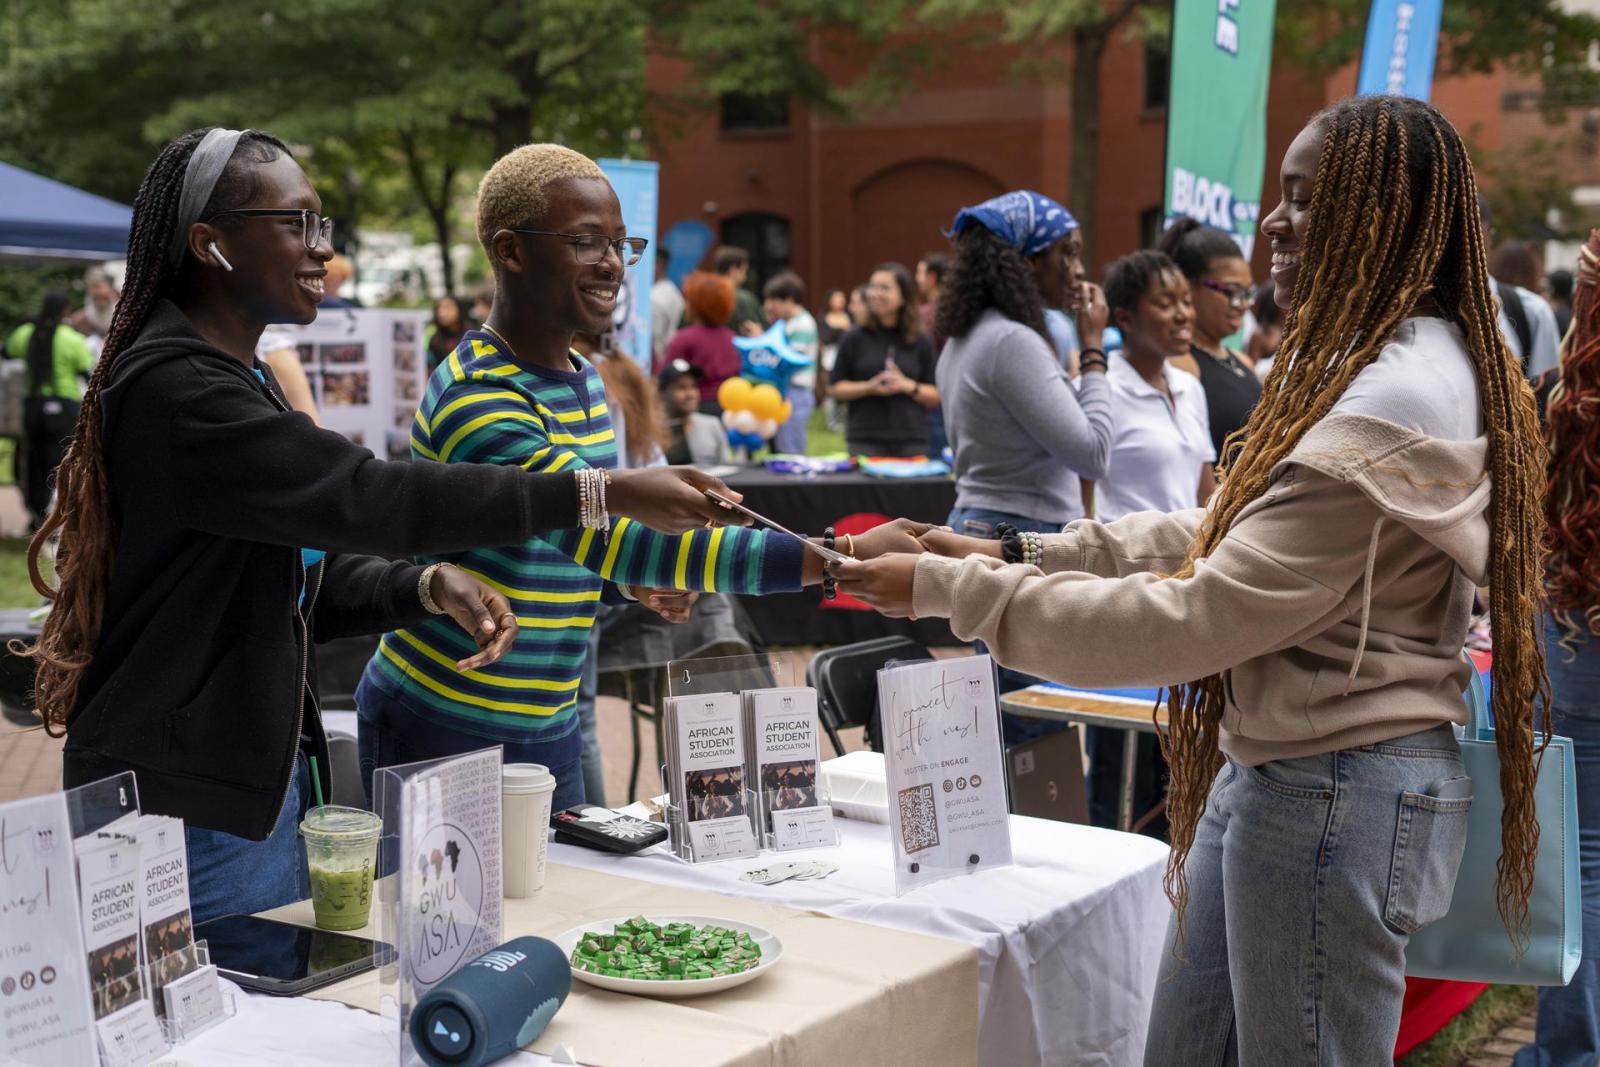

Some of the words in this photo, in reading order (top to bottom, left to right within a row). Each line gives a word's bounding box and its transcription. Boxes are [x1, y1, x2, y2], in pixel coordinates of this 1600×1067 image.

[1171, 166, 1233, 231] BLOCK
[688, 726, 733, 739] AFRICAN
[765, 720, 810, 732] AFRICAN
[689, 737, 735, 750] STUDENT
[766, 731, 811, 743] STUDENT
[766, 742, 811, 752] ASSOCIATION
[689, 749, 735, 759] ASSOCIATION
[941, 756, 969, 768] ENGAGE
[146, 857, 183, 881] AFRICAN
[91, 880, 134, 906] AFRICAN
[146, 872, 184, 896] STUDENT
[147, 887, 185, 908] ASSOCIATION
[420, 878, 456, 914] GWU
[91, 896, 135, 921] STUDENT
[92, 911, 134, 932] ASSOCIATION
[418, 909, 460, 967] ASA
[476, 951, 527, 972] JBL
